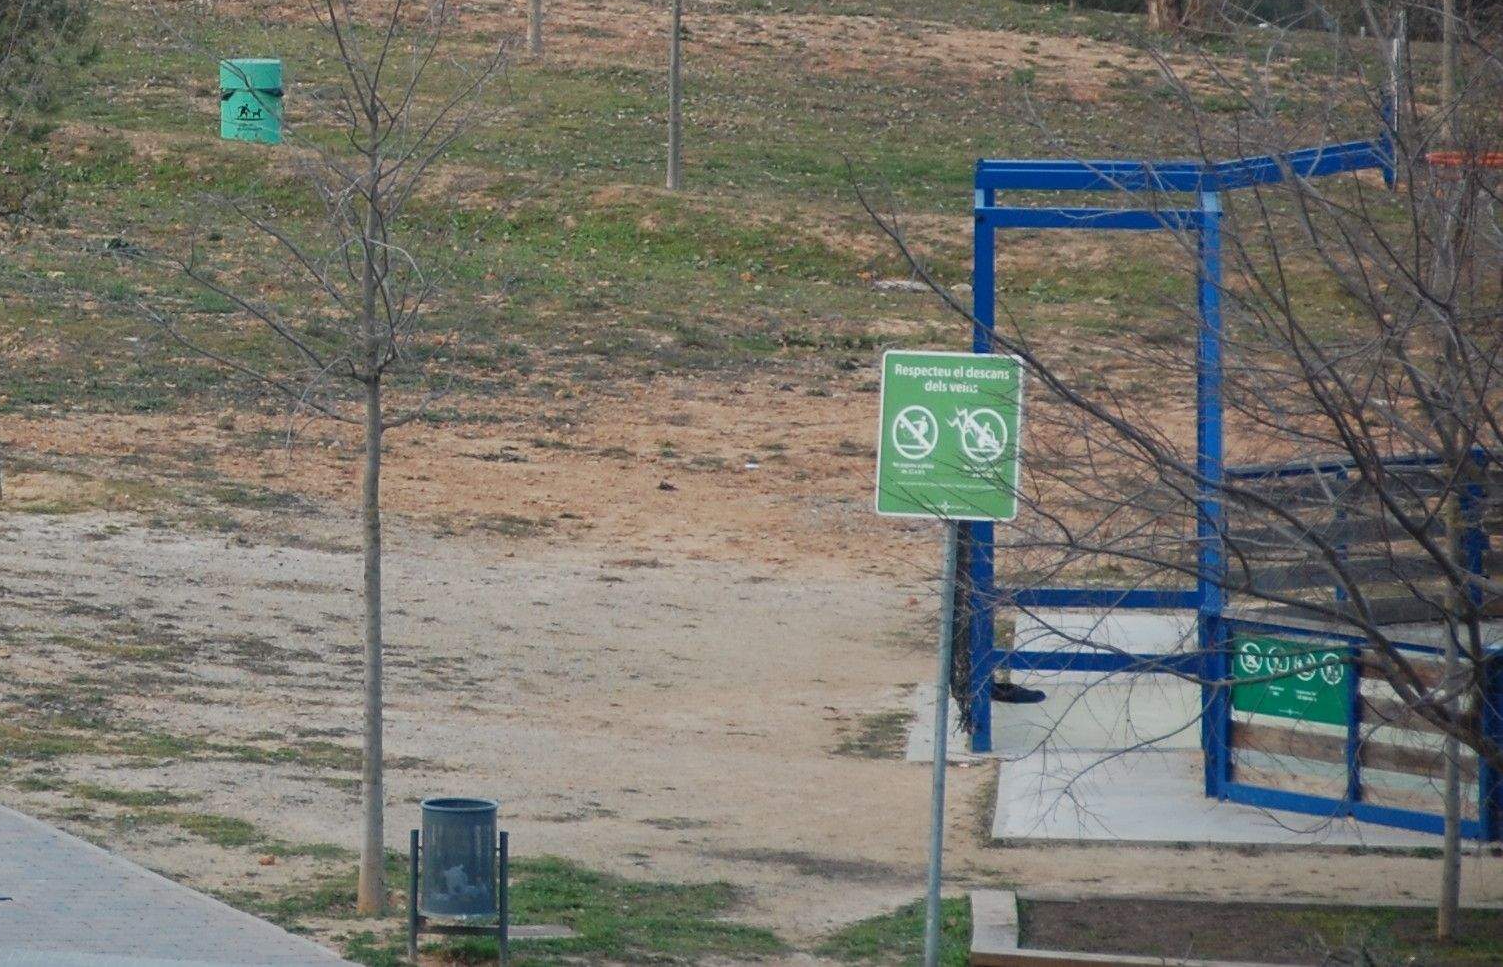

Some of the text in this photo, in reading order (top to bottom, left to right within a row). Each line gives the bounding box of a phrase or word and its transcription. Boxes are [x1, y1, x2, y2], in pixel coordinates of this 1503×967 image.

[894, 364, 1010, 380] Respecteu el descans
[924, 380, 948, 393] dels
